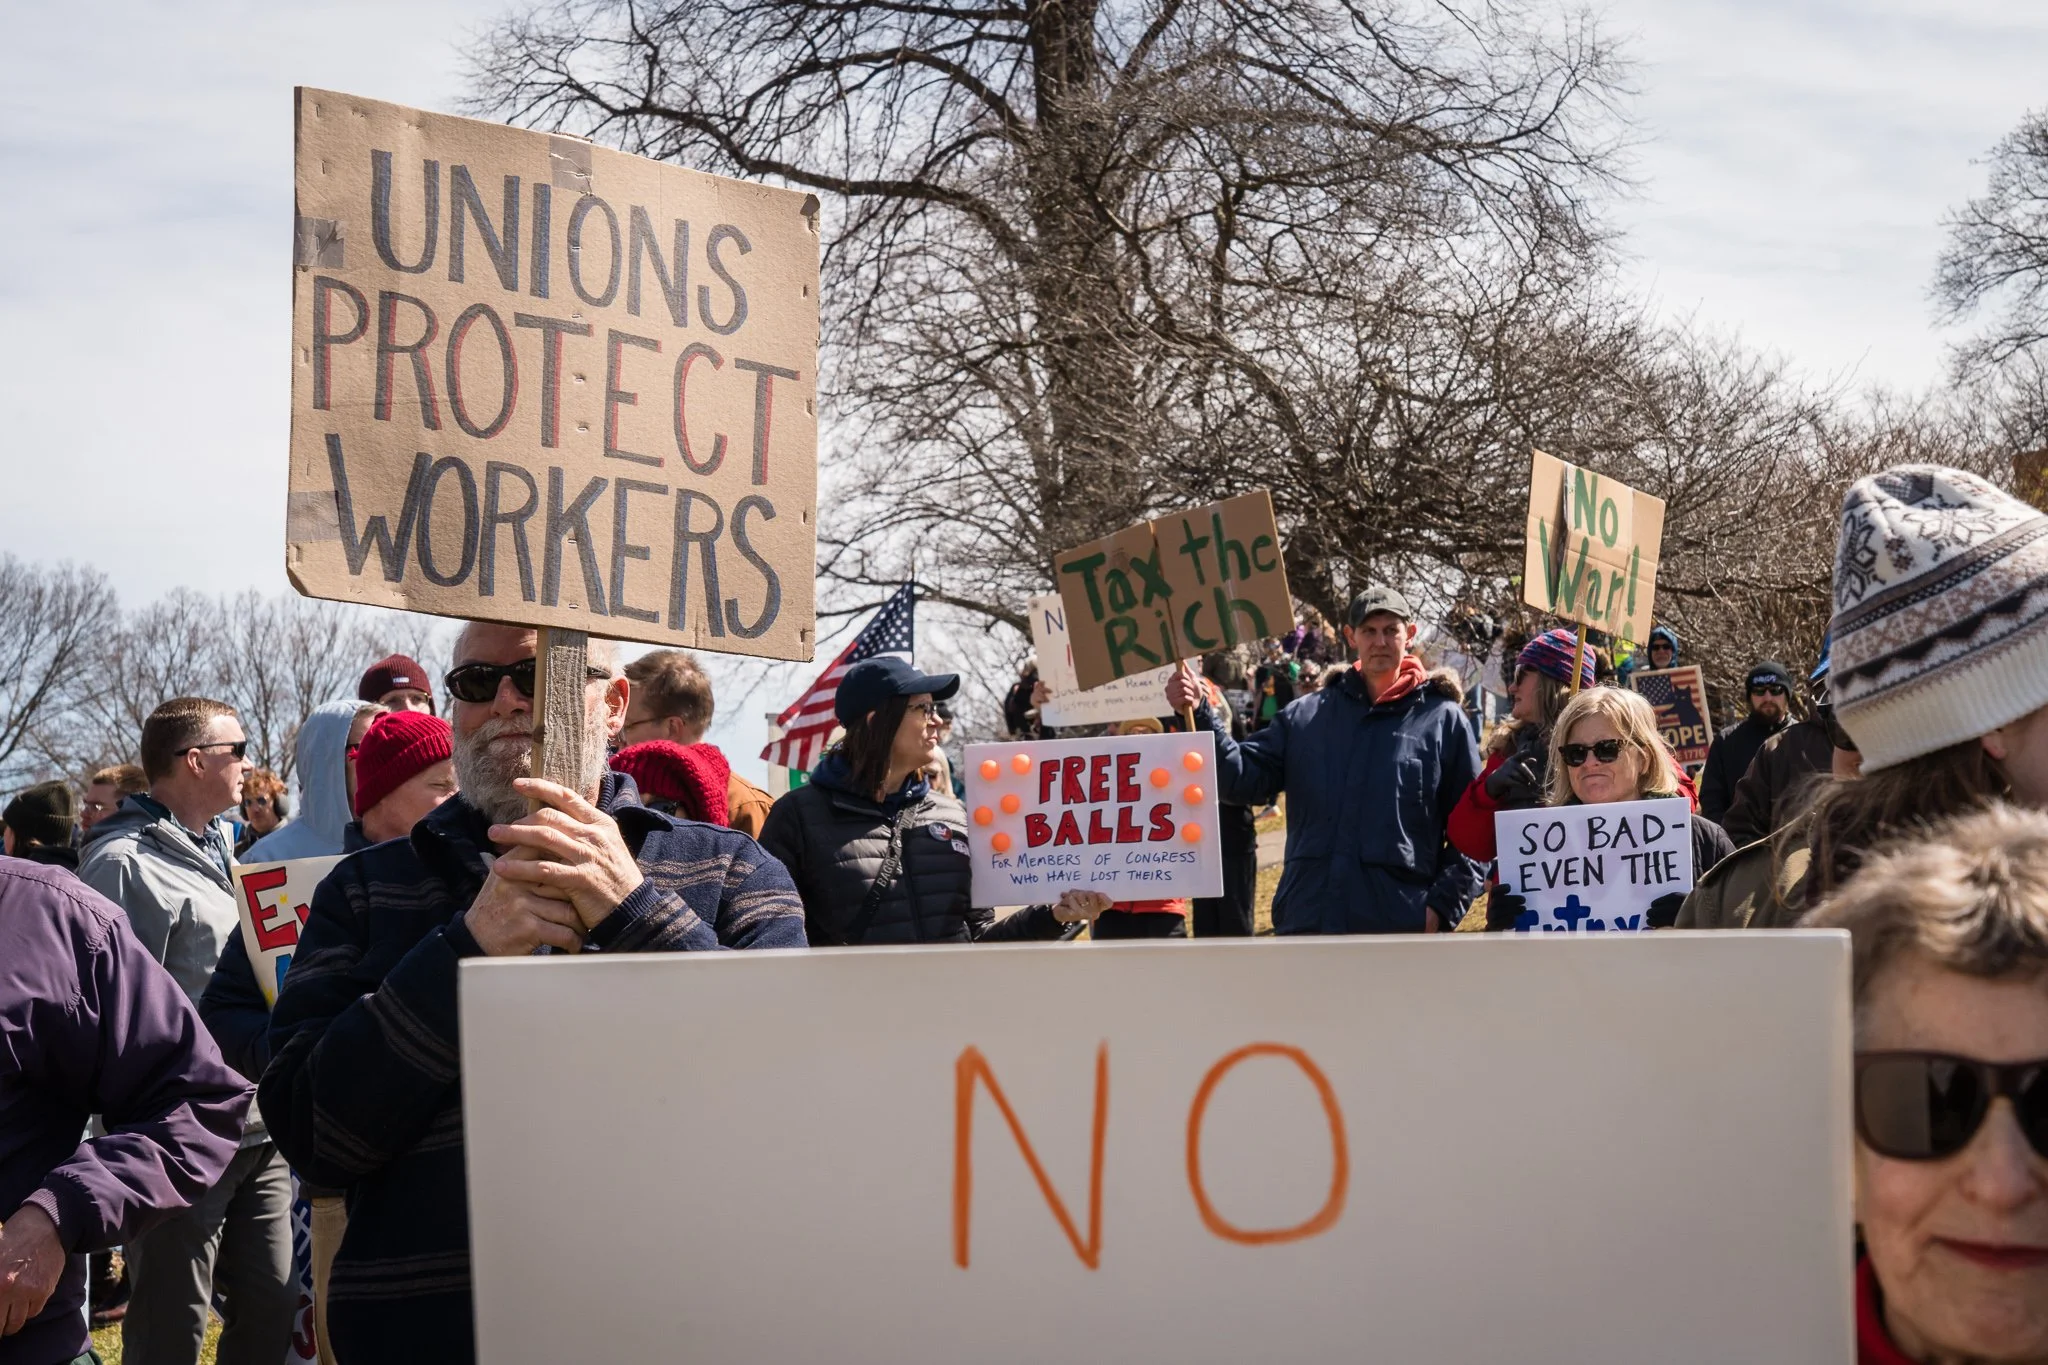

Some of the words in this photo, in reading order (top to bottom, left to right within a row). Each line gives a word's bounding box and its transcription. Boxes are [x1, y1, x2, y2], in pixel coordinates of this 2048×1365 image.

[371, 149, 752, 336] UNIONS
[313, 276, 800, 486] PROTECT
[325, 432, 781, 639] WORKERS
[1574, 467, 1619, 548] No
[1061, 549, 1173, 622] Tax
[1179, 512, 1277, 585] the
[1539, 515, 1640, 640] War!
[1104, 586, 1270, 678] Rich
[1662, 724, 1706, 748] OPE
[1039, 752, 1141, 805] FREE
[991, 852, 1013, 869] FOR
[1017, 852, 1081, 869] MEMBERS
[1094, 853, 1112, 866] OF
[1126, 851, 1196, 864] CONGRESS
[1025, 803, 1175, 848] BALLS
[1519, 821, 1566, 856] SO
[1587, 813, 1685, 851] BAD-
[1009, 873, 1039, 885] WHO
[1046, 869, 1082, 882] HAVE
[1090, 870, 1121, 882] LOST
[1127, 869, 1173, 881] THEIRS
[1519, 854, 1605, 893] EVEN
[1620, 850, 1681, 886] THE
[953, 1038, 1350, 1270] NO
